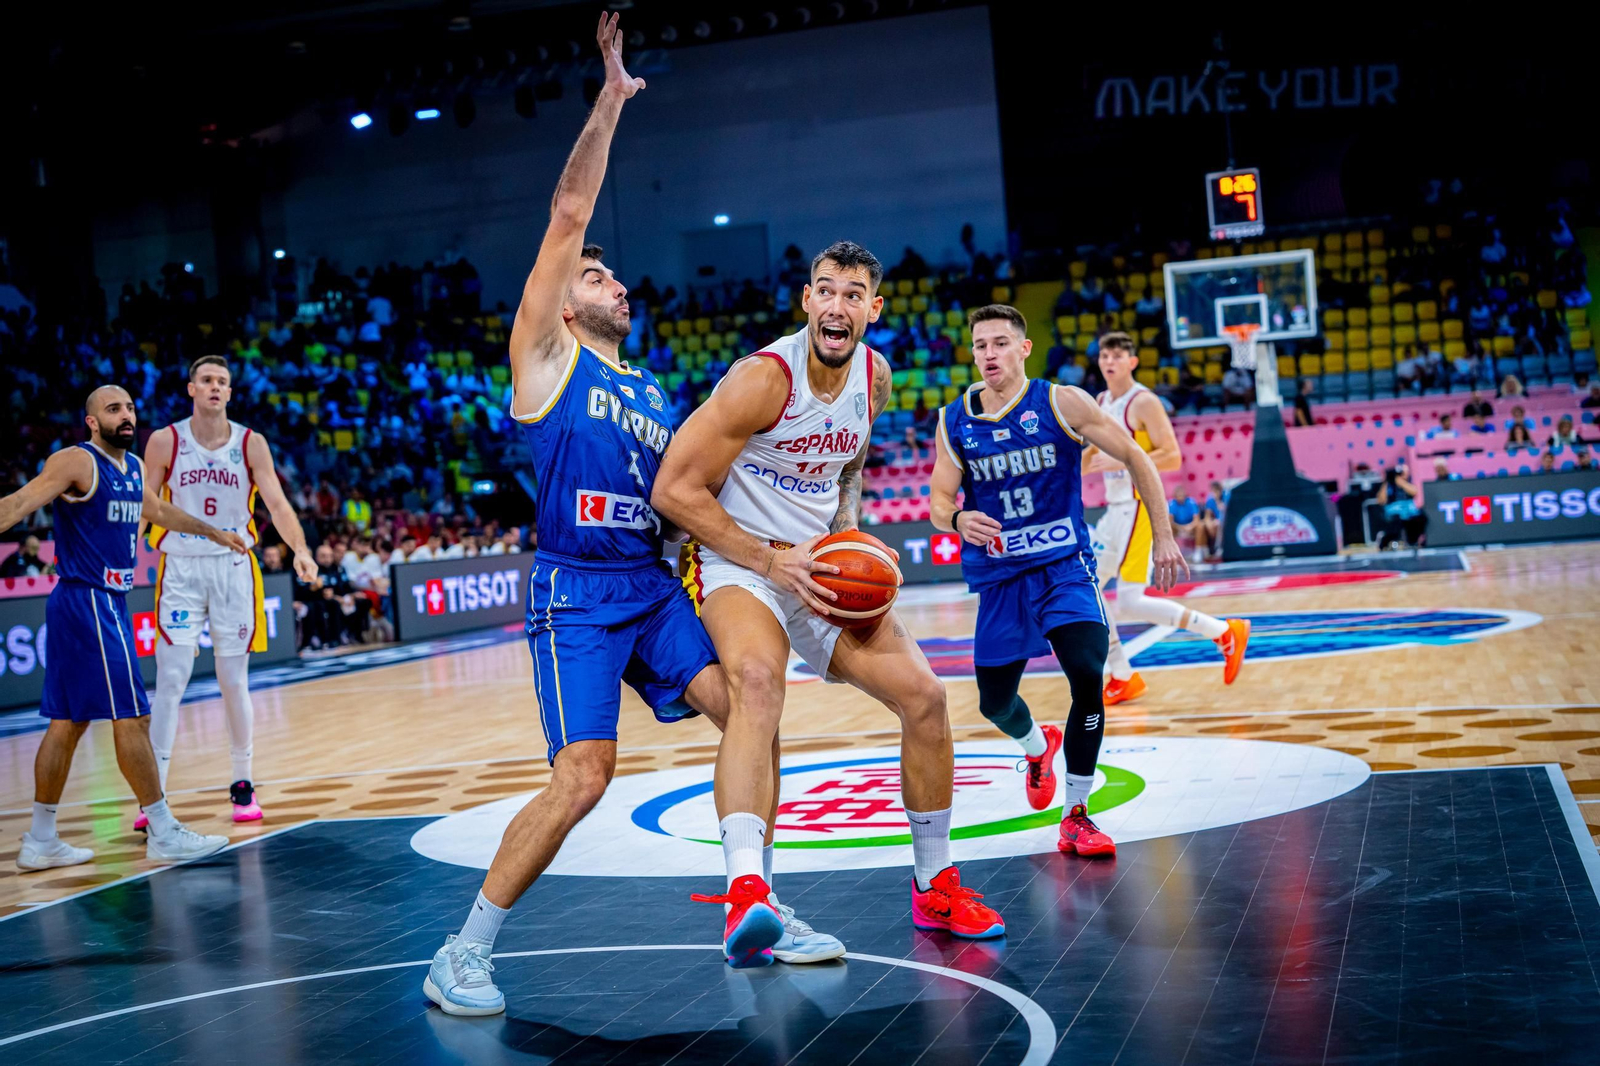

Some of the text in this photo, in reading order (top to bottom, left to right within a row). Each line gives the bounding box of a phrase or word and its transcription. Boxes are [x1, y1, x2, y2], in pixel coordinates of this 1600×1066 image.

[1095, 64, 1400, 118] MAKE YOUR
[180, 468, 239, 490] ESPAÑA
[204, 497, 217, 516] 6
[999, 487, 1035, 520] 13
[1007, 525, 1071, 552] EKO
[444, 570, 520, 613] TISSOT
[831, 588, 873, 602] molte
